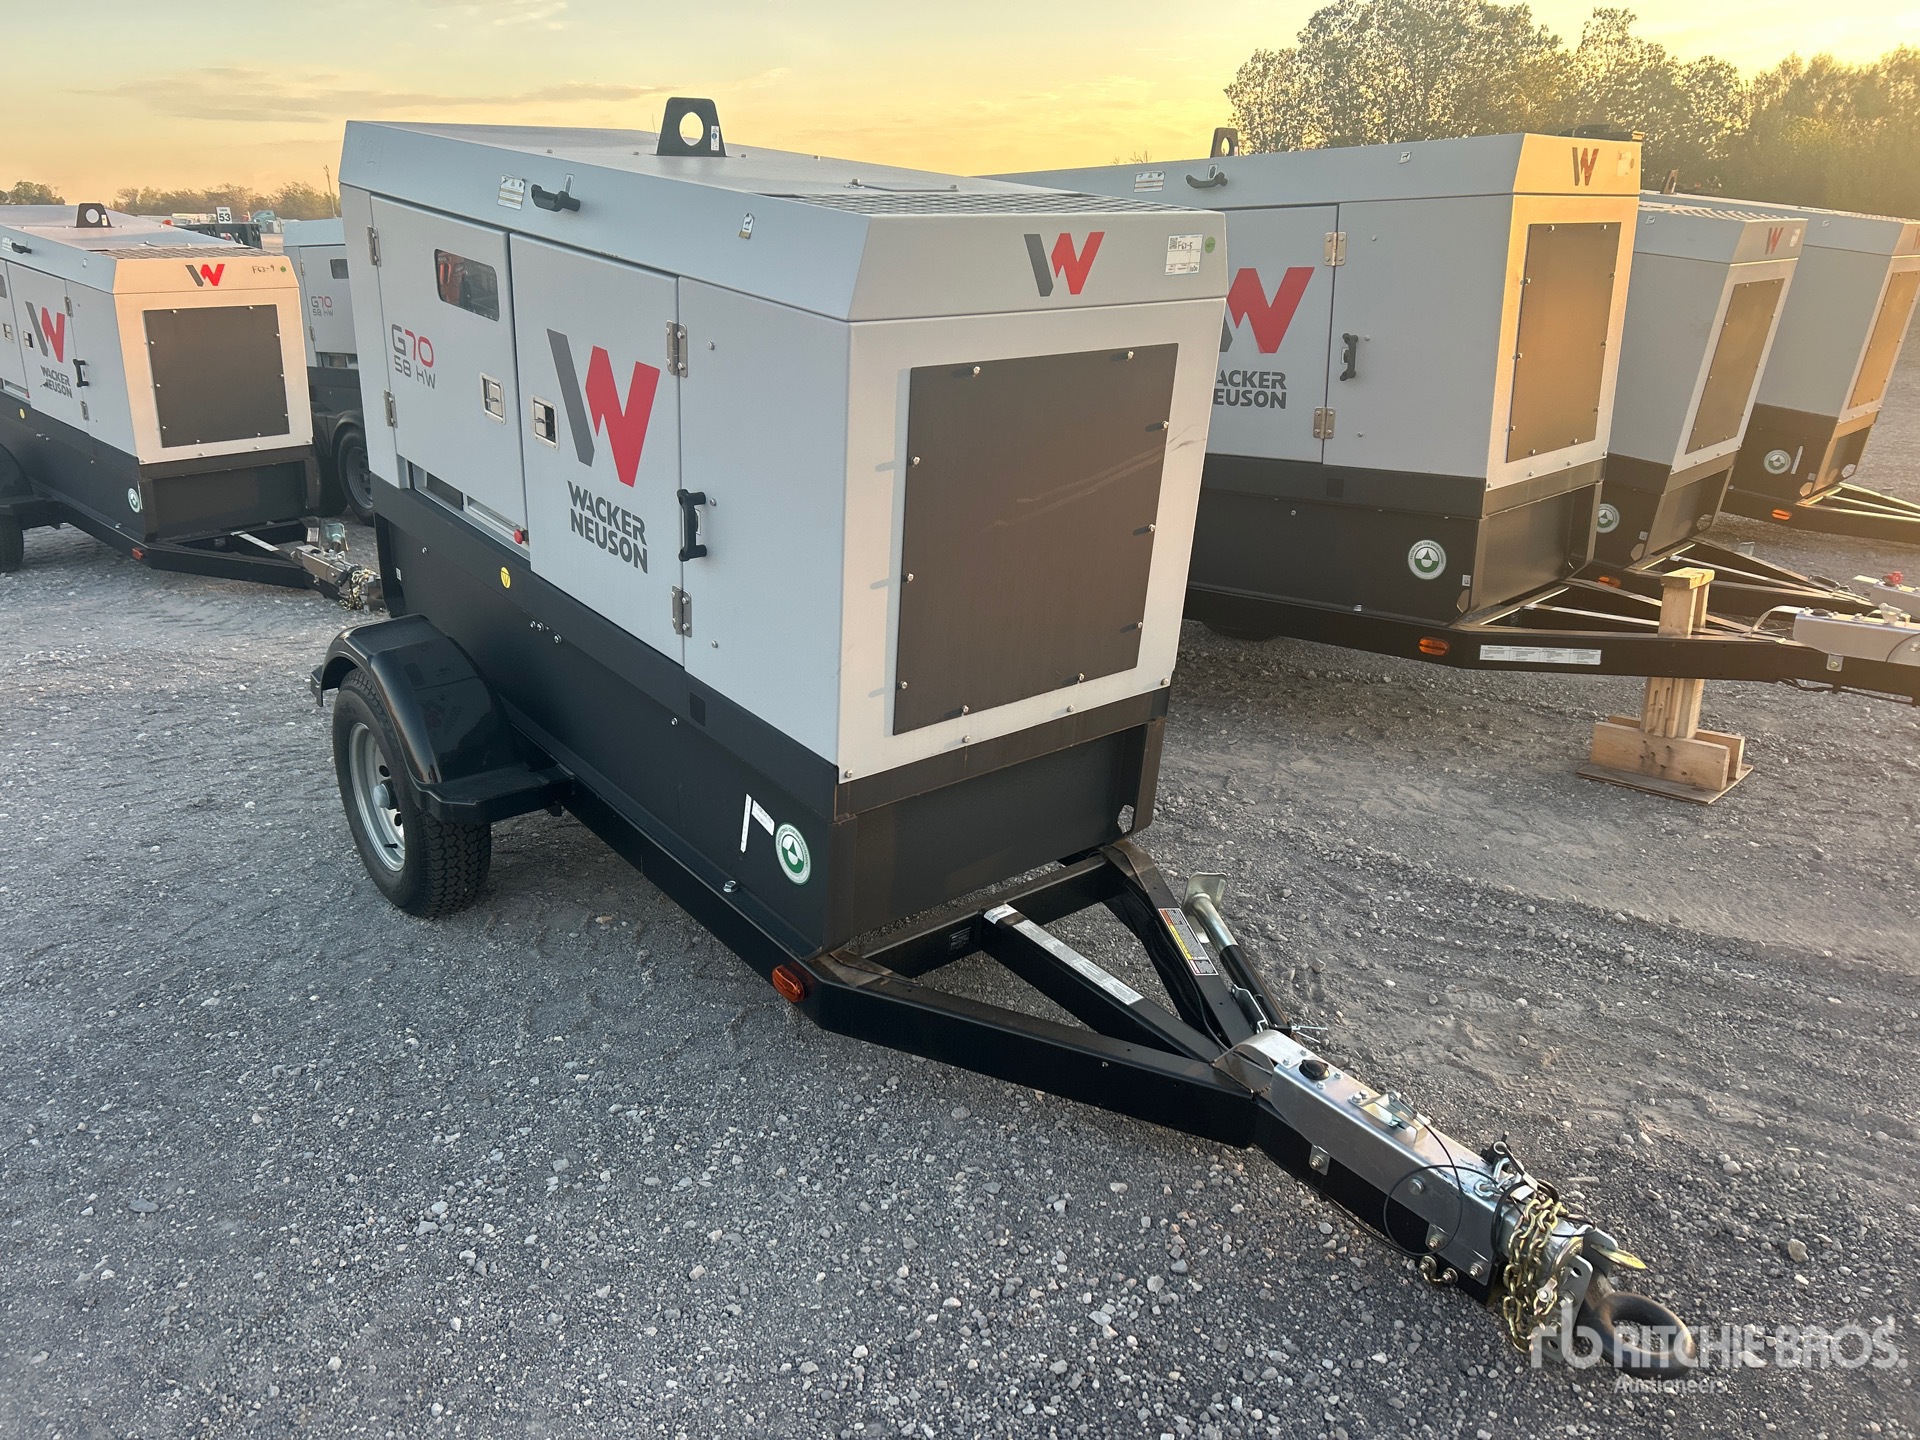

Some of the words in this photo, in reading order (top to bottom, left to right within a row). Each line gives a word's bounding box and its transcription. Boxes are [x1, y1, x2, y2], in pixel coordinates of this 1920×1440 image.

[218, 212, 231, 222] 53
[310, 295, 333, 308] G70
[391, 323, 434, 368] G70
[40, 364, 71, 387] WACKER
[394, 354, 412, 378] 58
[1217, 369, 1287, 390] ACKER
[1213, 388, 1287, 409] EUSON
[567, 480, 648, 546] WACKER
[570, 508, 648, 574] NEUSON
